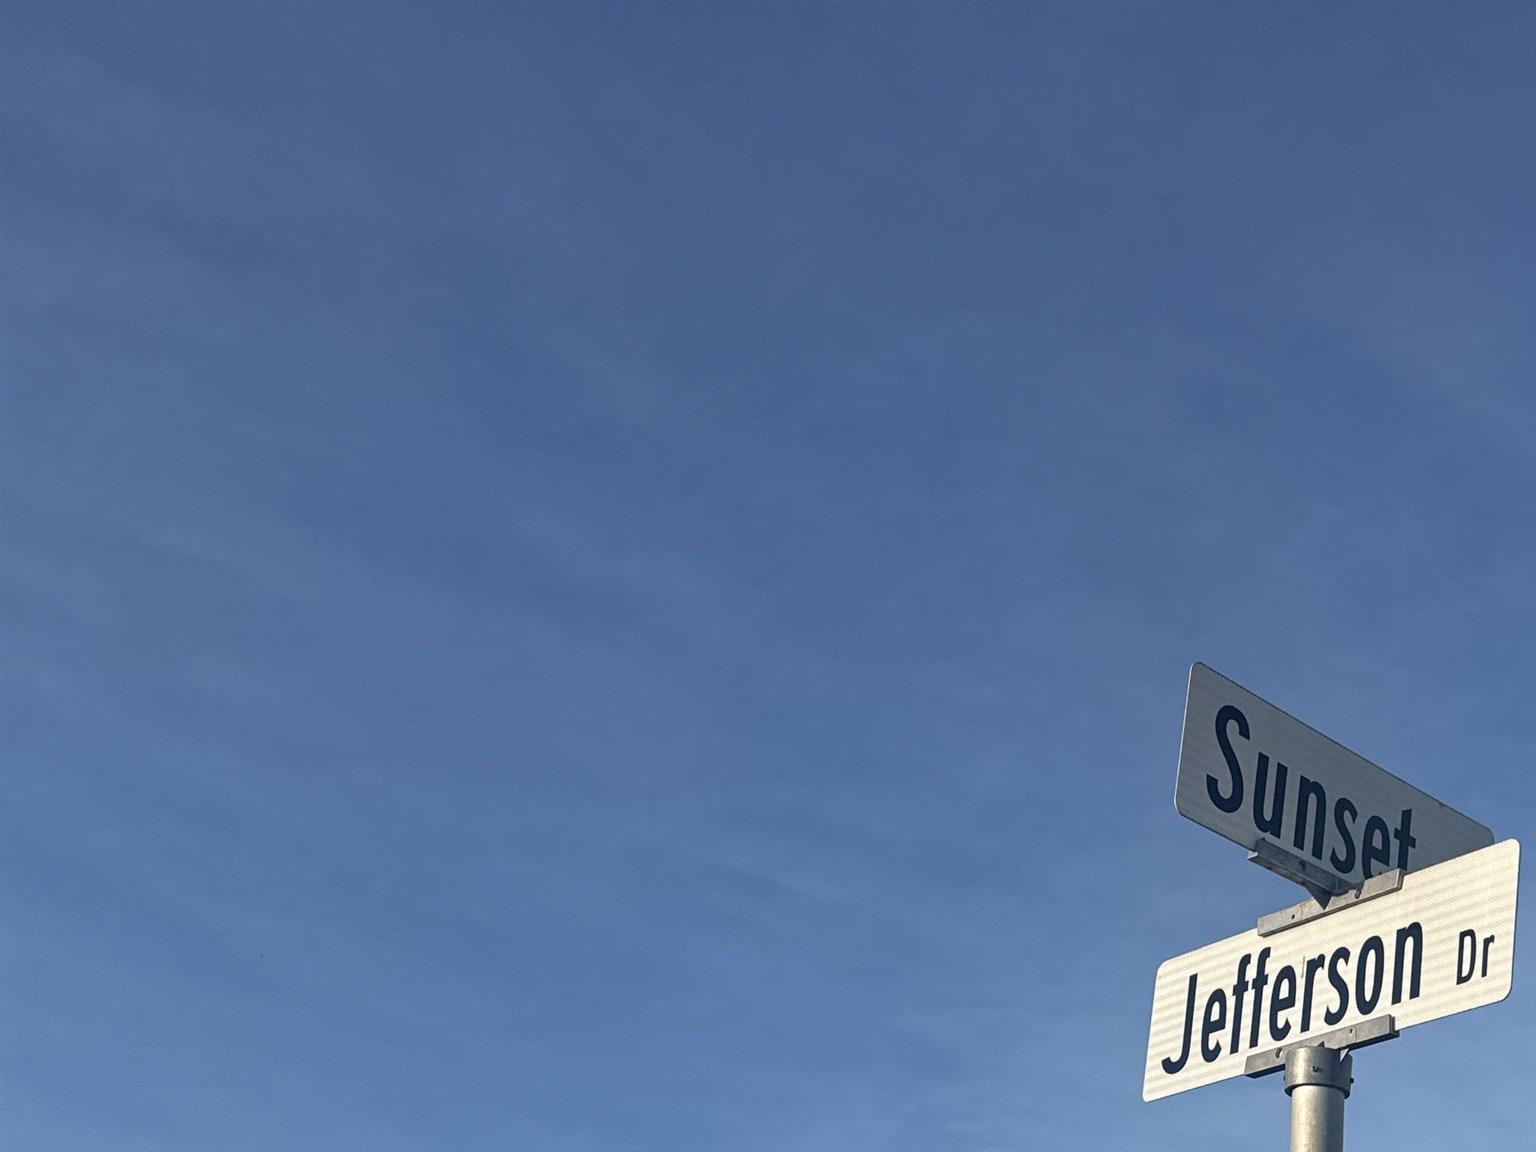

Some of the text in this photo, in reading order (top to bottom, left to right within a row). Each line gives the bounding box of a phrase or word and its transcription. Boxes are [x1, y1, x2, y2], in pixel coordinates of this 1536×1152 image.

[1206, 704, 1417, 880] Sunset
[1161, 921, 1495, 1075] Jefferson Dr
